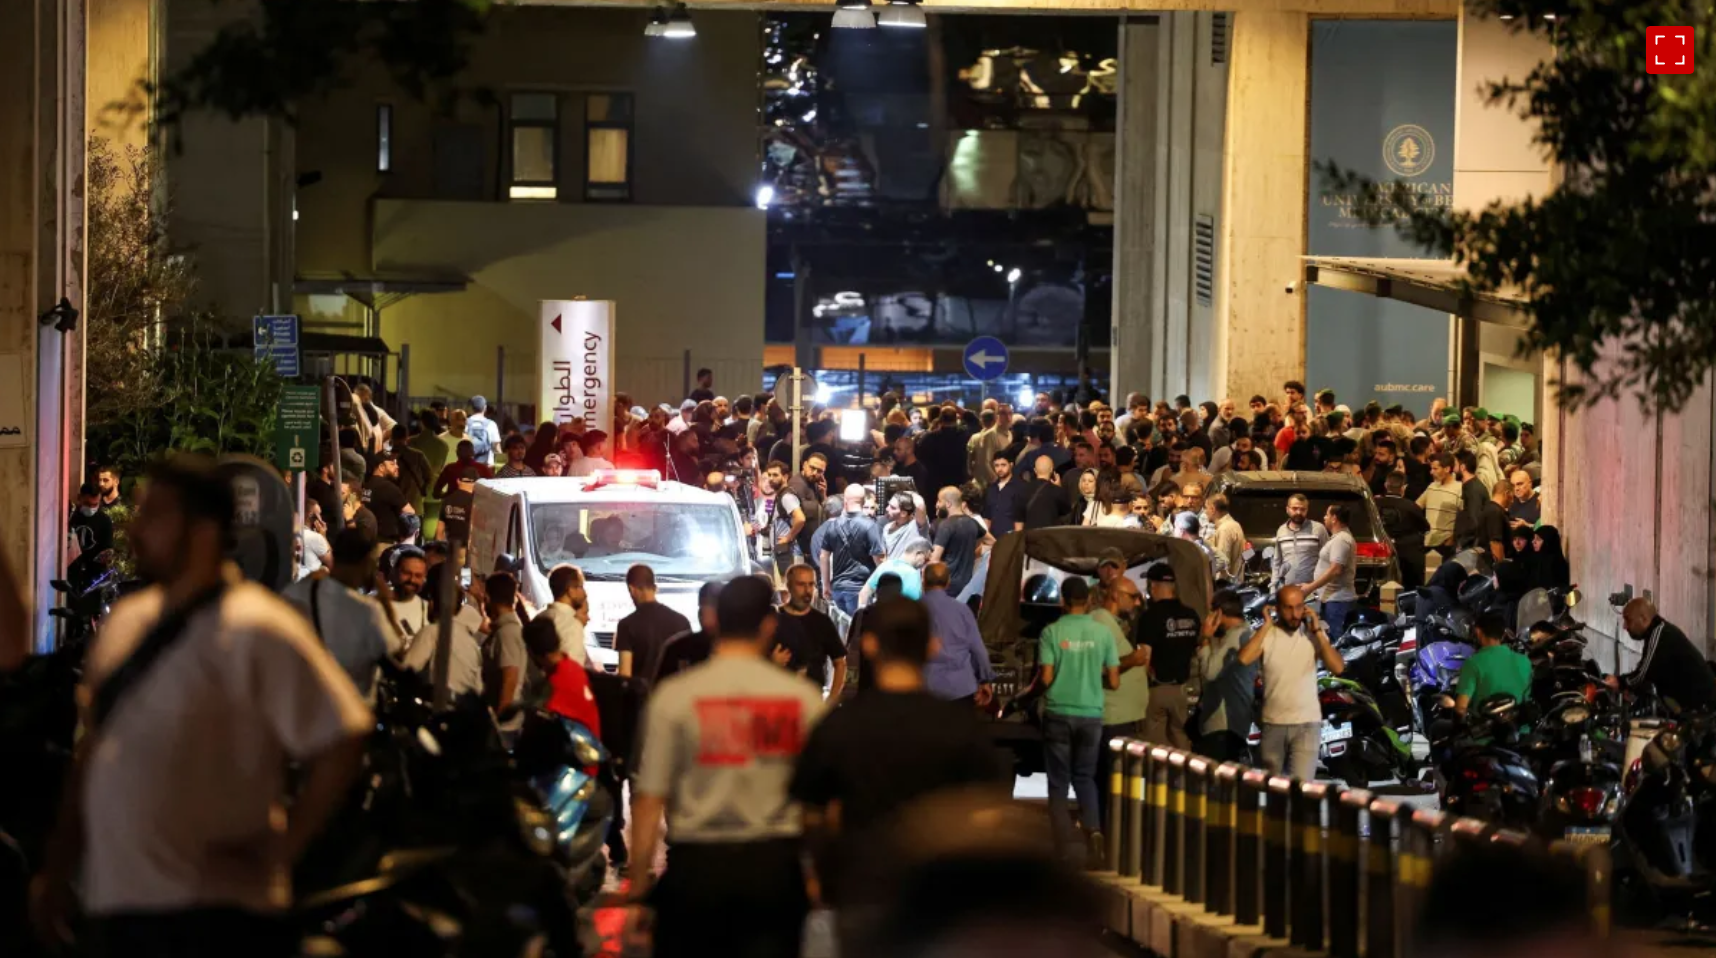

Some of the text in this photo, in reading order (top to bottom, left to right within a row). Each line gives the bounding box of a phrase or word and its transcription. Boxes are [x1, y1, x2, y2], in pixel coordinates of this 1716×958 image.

[552, 361, 574, 424] الطوار
[584, 331, 602, 432] mergency
[1374, 382, 1435, 392] aubmc.care
